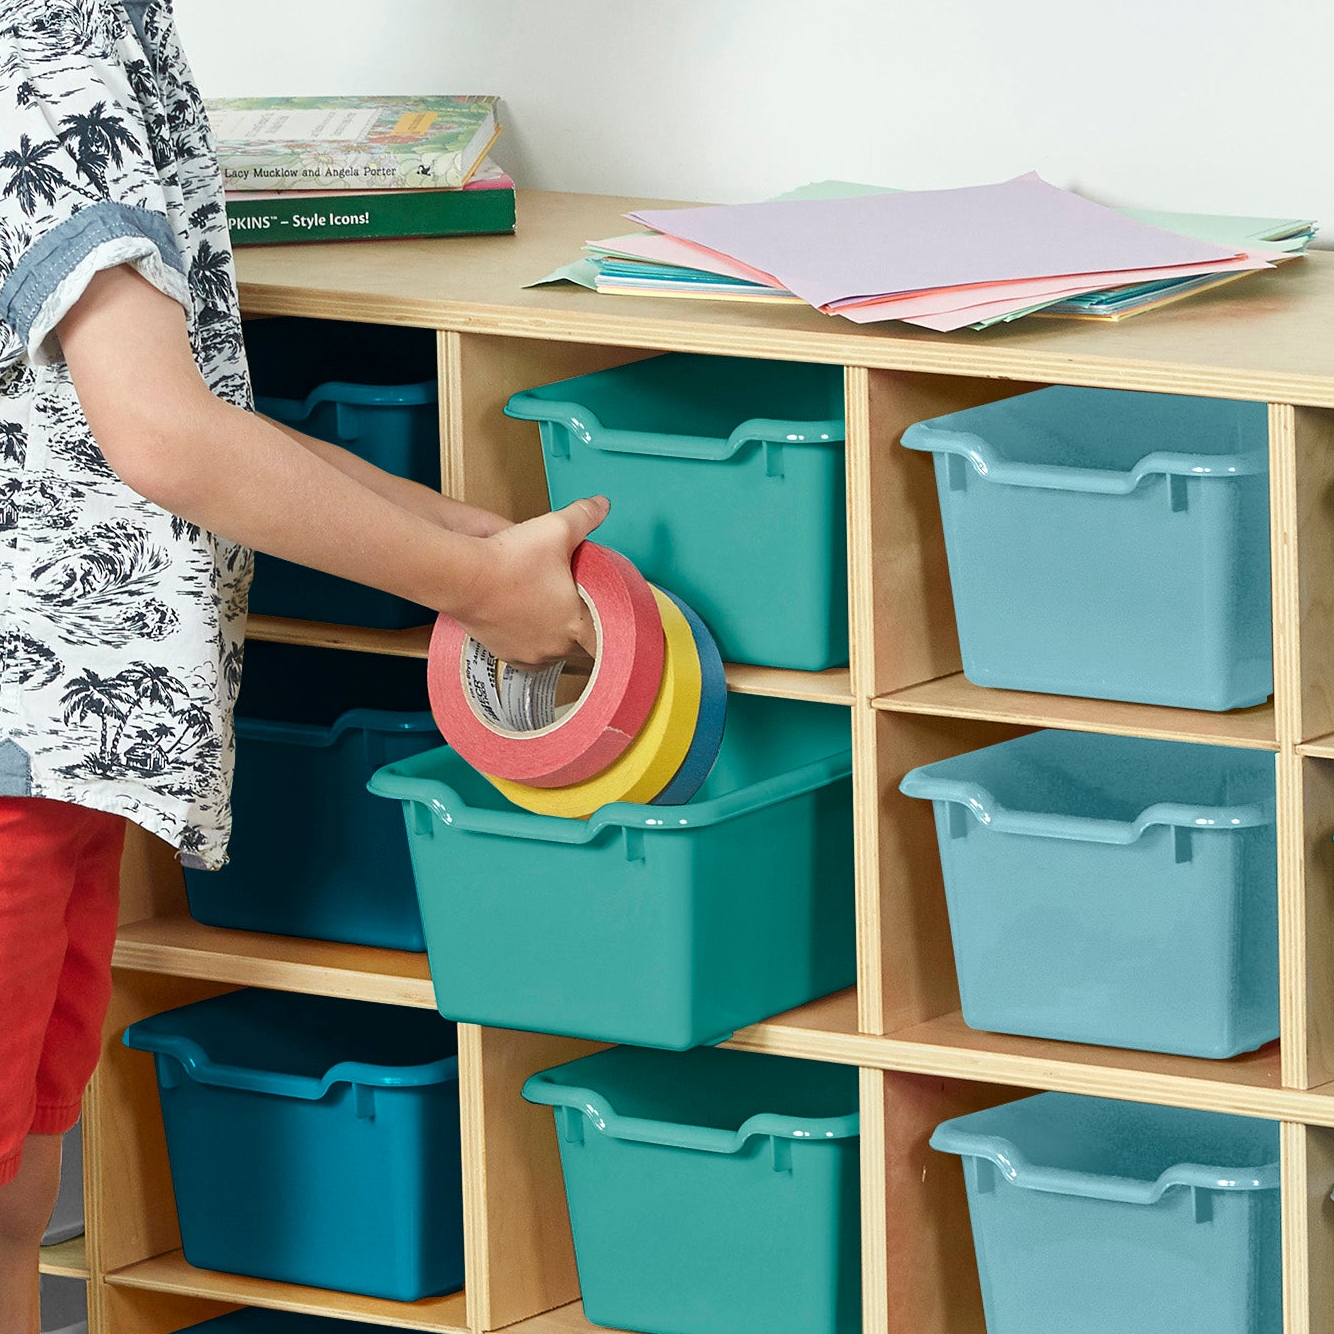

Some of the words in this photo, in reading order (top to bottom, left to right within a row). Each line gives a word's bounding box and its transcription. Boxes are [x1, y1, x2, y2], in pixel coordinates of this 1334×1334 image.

[224, 168, 249, 180] Lacy
[253, 167, 298, 178] Mucklow
[302, 167, 321, 177] and
[325, 167, 359, 179] Angela
[363, 166, 397, 177] Porter
[292, 213, 326, 230] Style
[329, 211, 370, 226] Icons!
